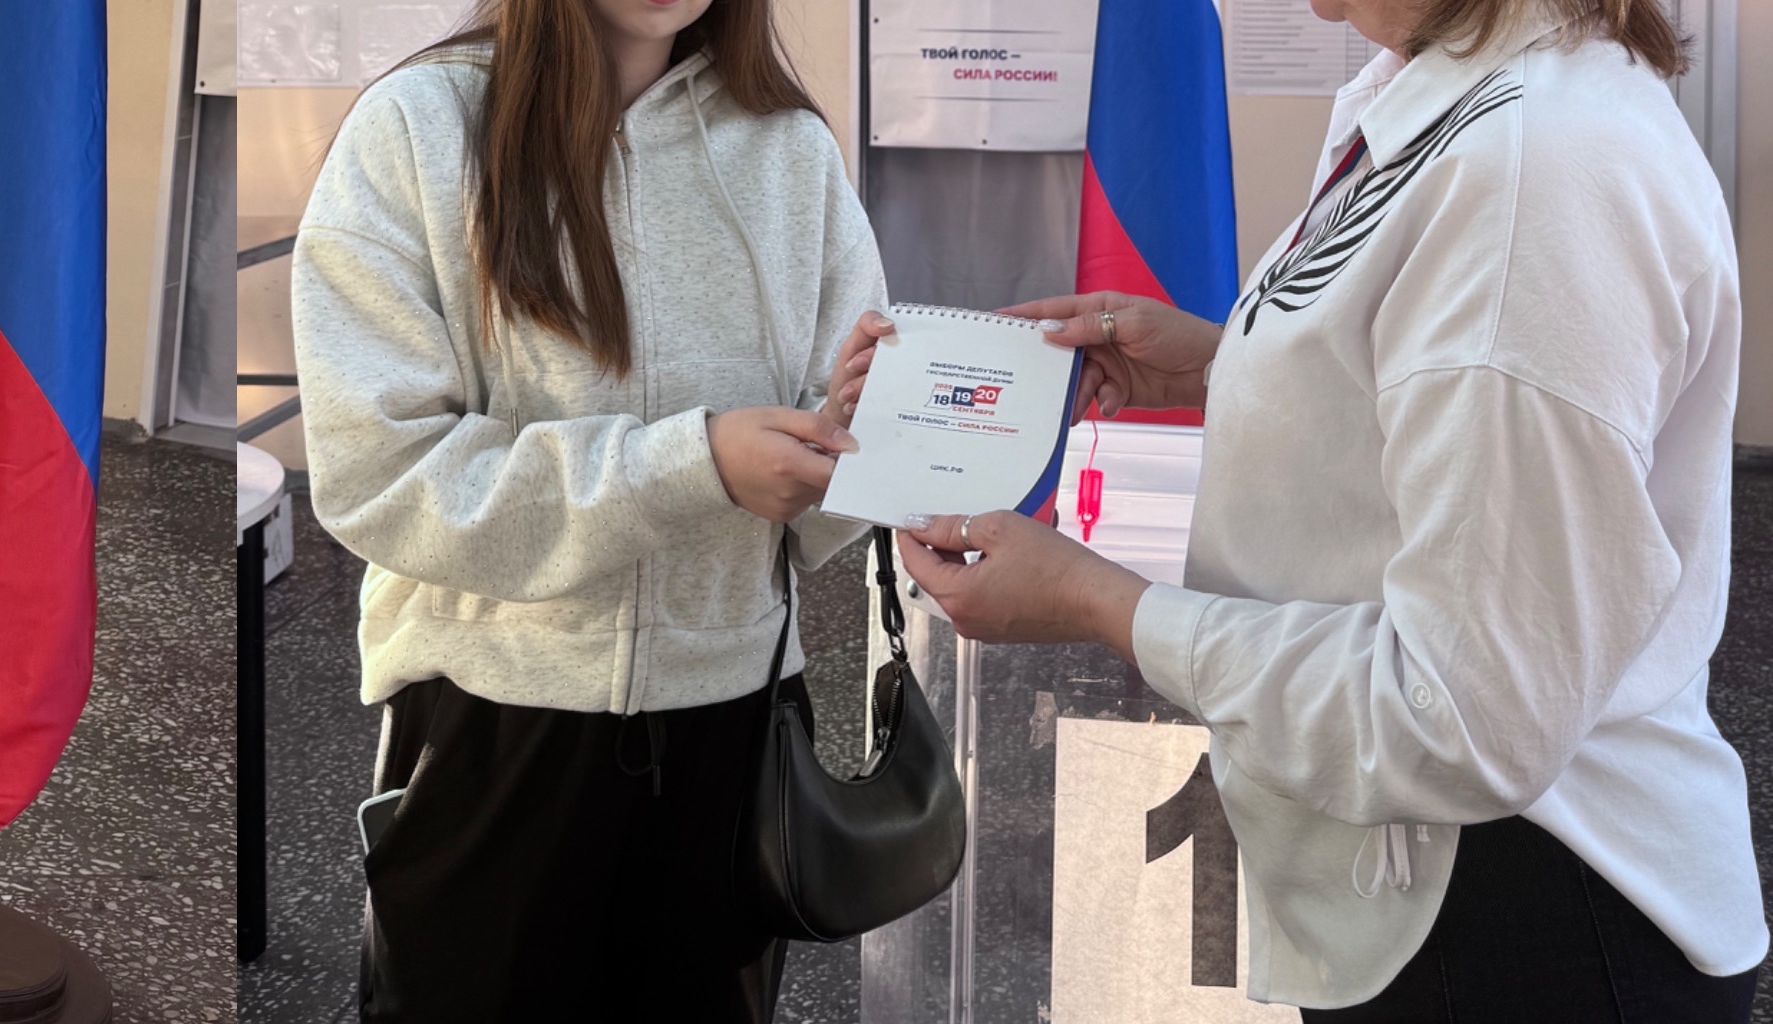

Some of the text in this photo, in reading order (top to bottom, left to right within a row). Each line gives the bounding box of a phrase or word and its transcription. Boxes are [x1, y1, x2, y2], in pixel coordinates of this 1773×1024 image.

[921, 46, 959, 59] ТВОЙ
[961, 49, 1008, 60] ГОЛОС
[953, 68, 1058, 82] СИЛА РОССИИ!
[966, 365, 1014, 377] ДЕПУТАТОВ
[934, 388, 997, 405] 18 19 20
[897, 413, 920, 422] ТВОЙ
[920, 416, 949, 426] ГОЛОС
[1146, 752, 1238, 988] 1
